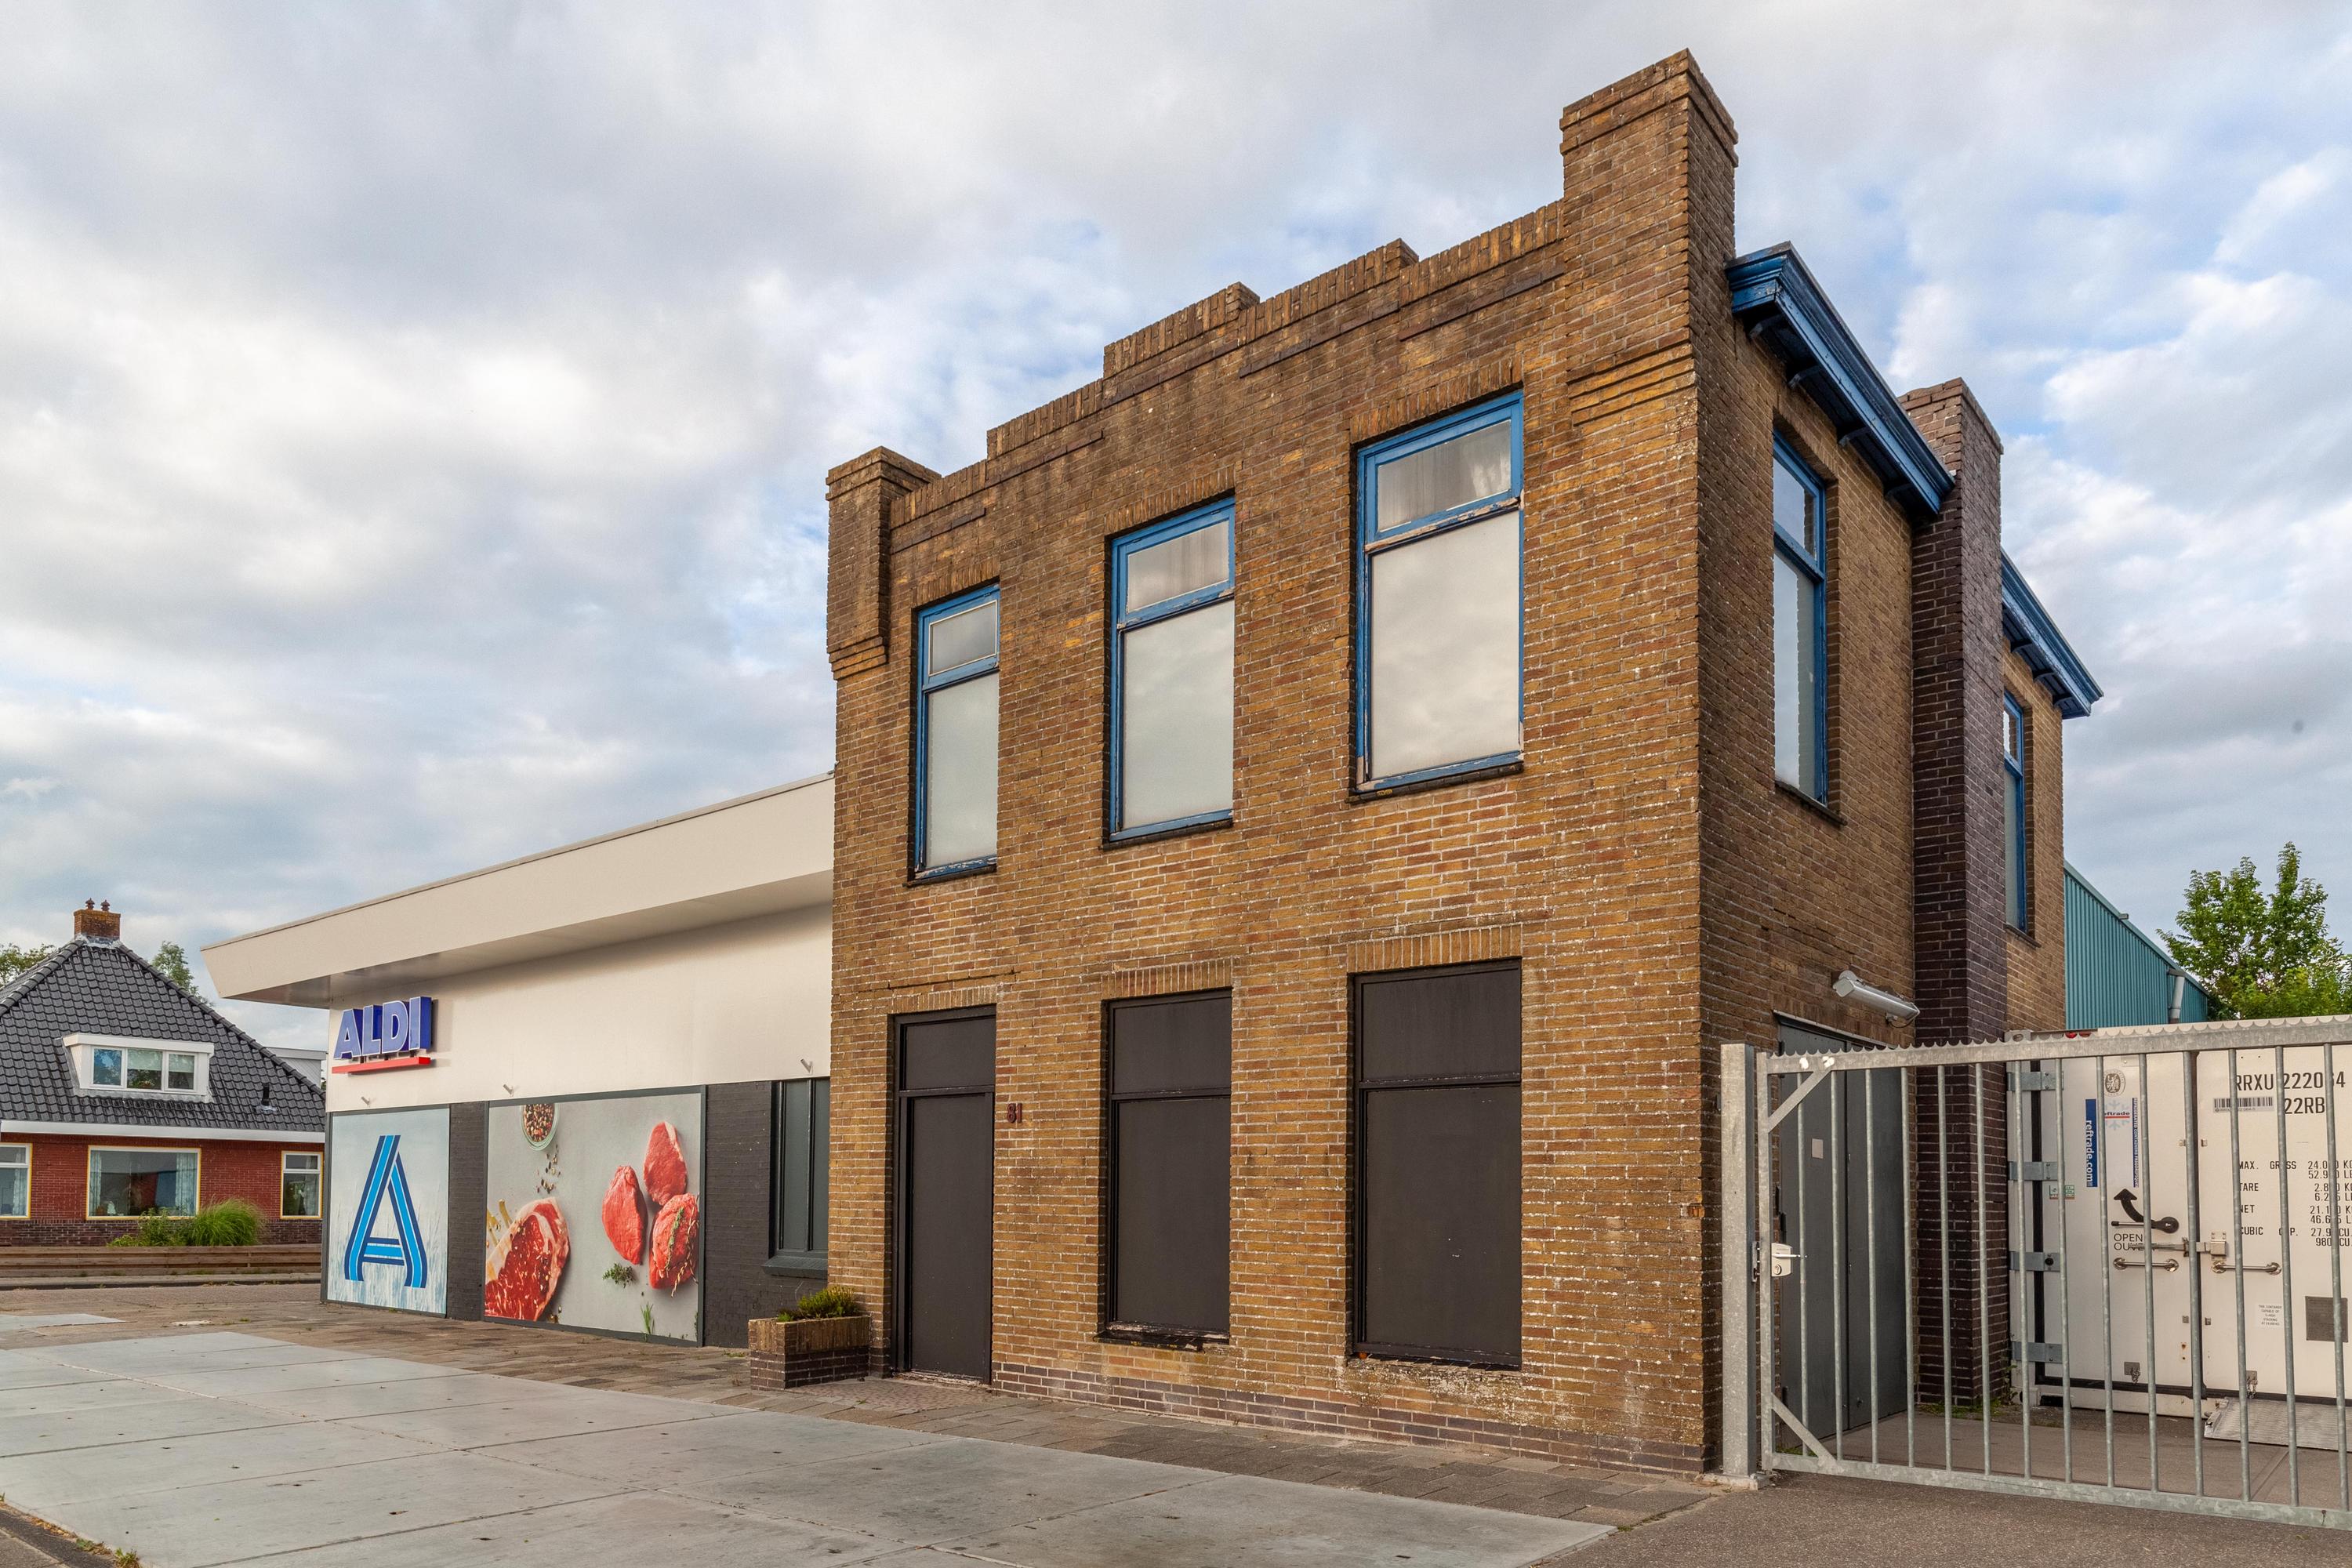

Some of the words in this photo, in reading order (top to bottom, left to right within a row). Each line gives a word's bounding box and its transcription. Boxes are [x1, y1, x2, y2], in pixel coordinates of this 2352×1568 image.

[333, 996, 431, 1059] ALDI
[2236, 1074, 2274, 1091] RRXU
[2283, 1072, 2346, 1089] 22204
[2285, 1097, 2325, 1114] 22RB
[1007, 1102, 1022, 1123] 81
[2085, 1120, 2094, 1181] reftrade.com
[2308, 1160, 2339, 1169] 24.00
[2308, 1171, 2339, 1179] 52.90
[2314, 1183, 2340, 1192] 2.80
[2310, 1206, 2341, 1214] 21.10
[2279, 1228, 2299, 1236] CP.
[2114, 1233, 2143, 1242] OPEN
